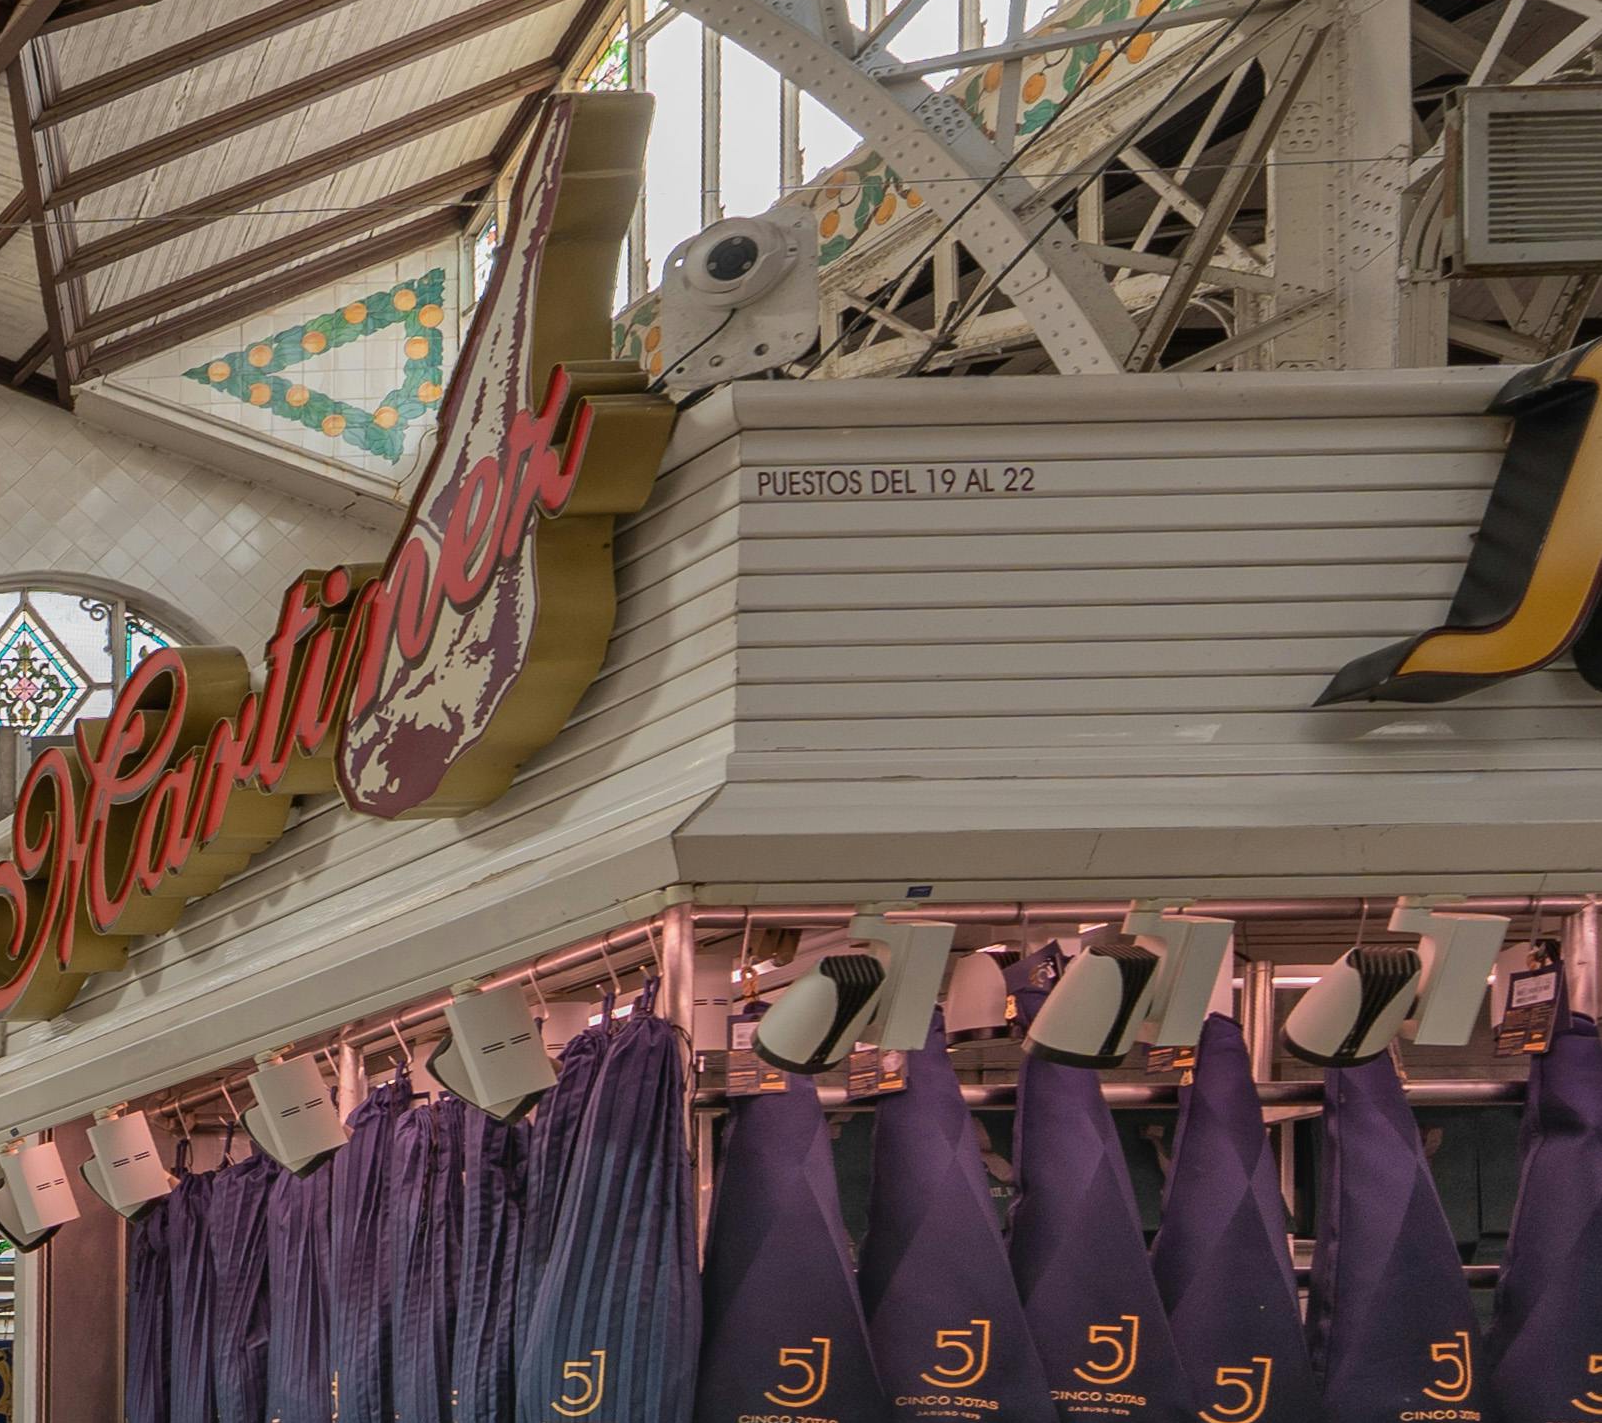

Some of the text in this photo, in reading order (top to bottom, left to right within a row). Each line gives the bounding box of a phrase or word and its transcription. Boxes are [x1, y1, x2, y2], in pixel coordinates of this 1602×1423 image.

[757, 467, 1035, 496] PUESTOS DEL 19 AL 22
[552, 1350, 606, 1418] 5J
[764, 1336, 831, 1409] 5J
[920, 1319, 991, 1389] 5J
[1073, 1314, 1139, 1386] 5J
[1422, 1331, 1473, 1403] 5J
[895, 1395, 999, 1412] CINCO JOTAS
[1050, 1390, 1147, 1408] CINCO JOTAS
[1399, 1409, 1457, 1423] CINCO
